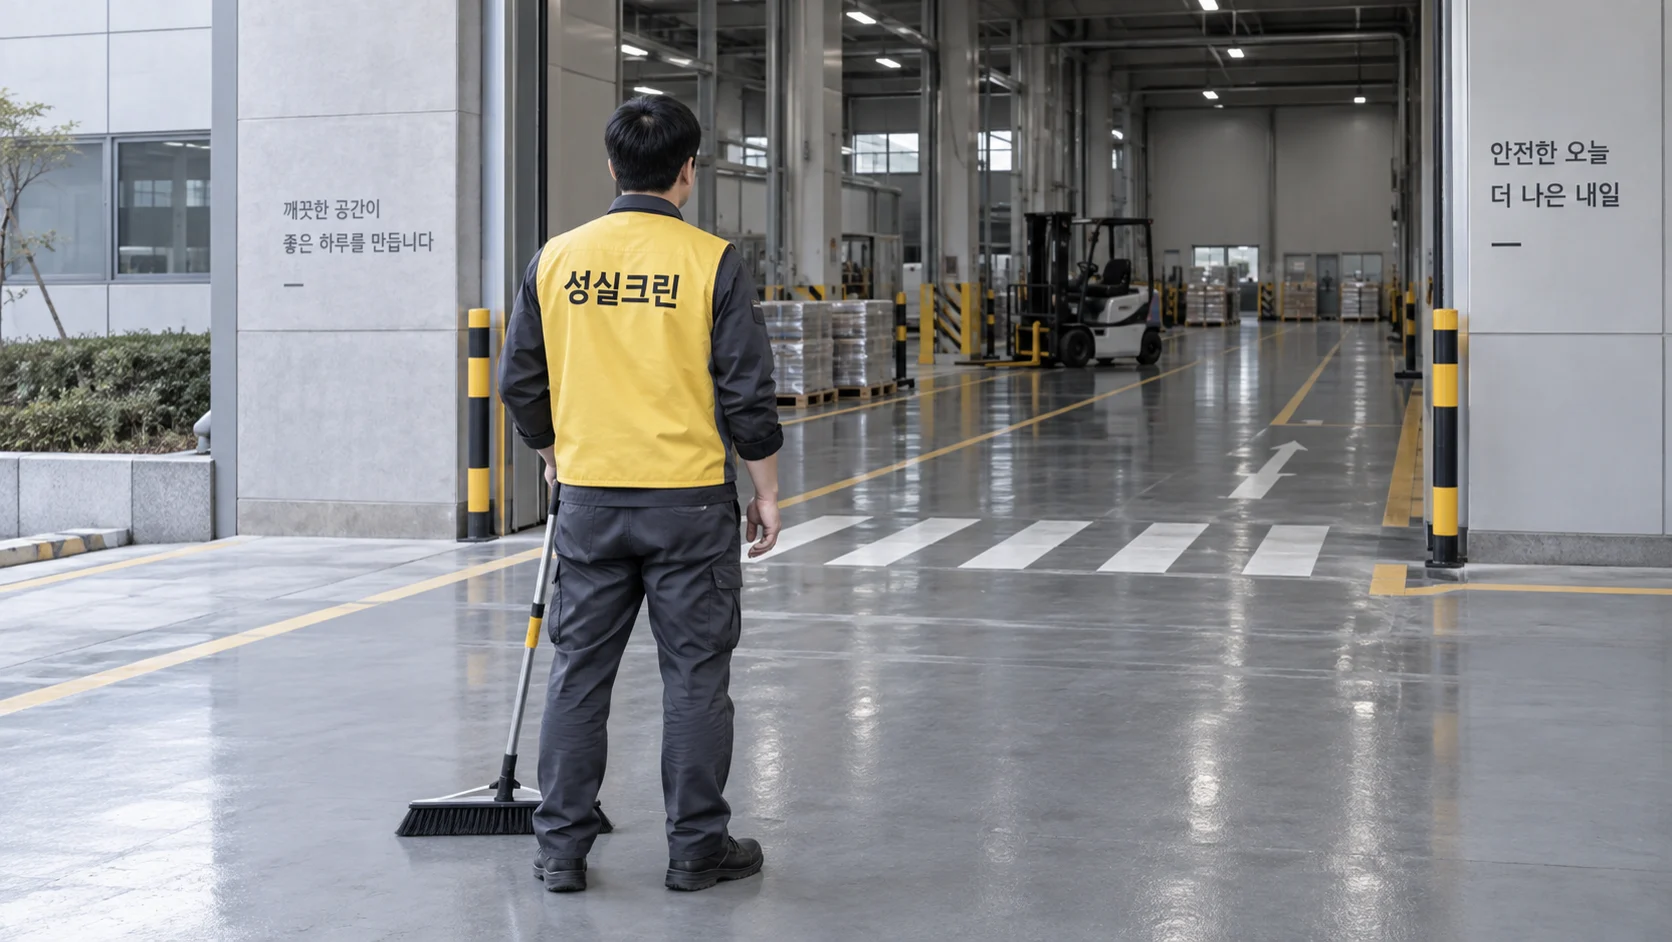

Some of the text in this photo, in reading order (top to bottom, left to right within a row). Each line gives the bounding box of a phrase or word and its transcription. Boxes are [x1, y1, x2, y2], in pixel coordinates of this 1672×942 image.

[1490, 139, 1610, 166] 안전한 오늘
[1491, 181, 1620, 209] 더 나은 내일
[283, 199, 380, 220] 깨끗한 공간이
[283, 231, 434, 254] 좋은 하루를 만듭니다
[564, 270, 680, 309] 성실크린
